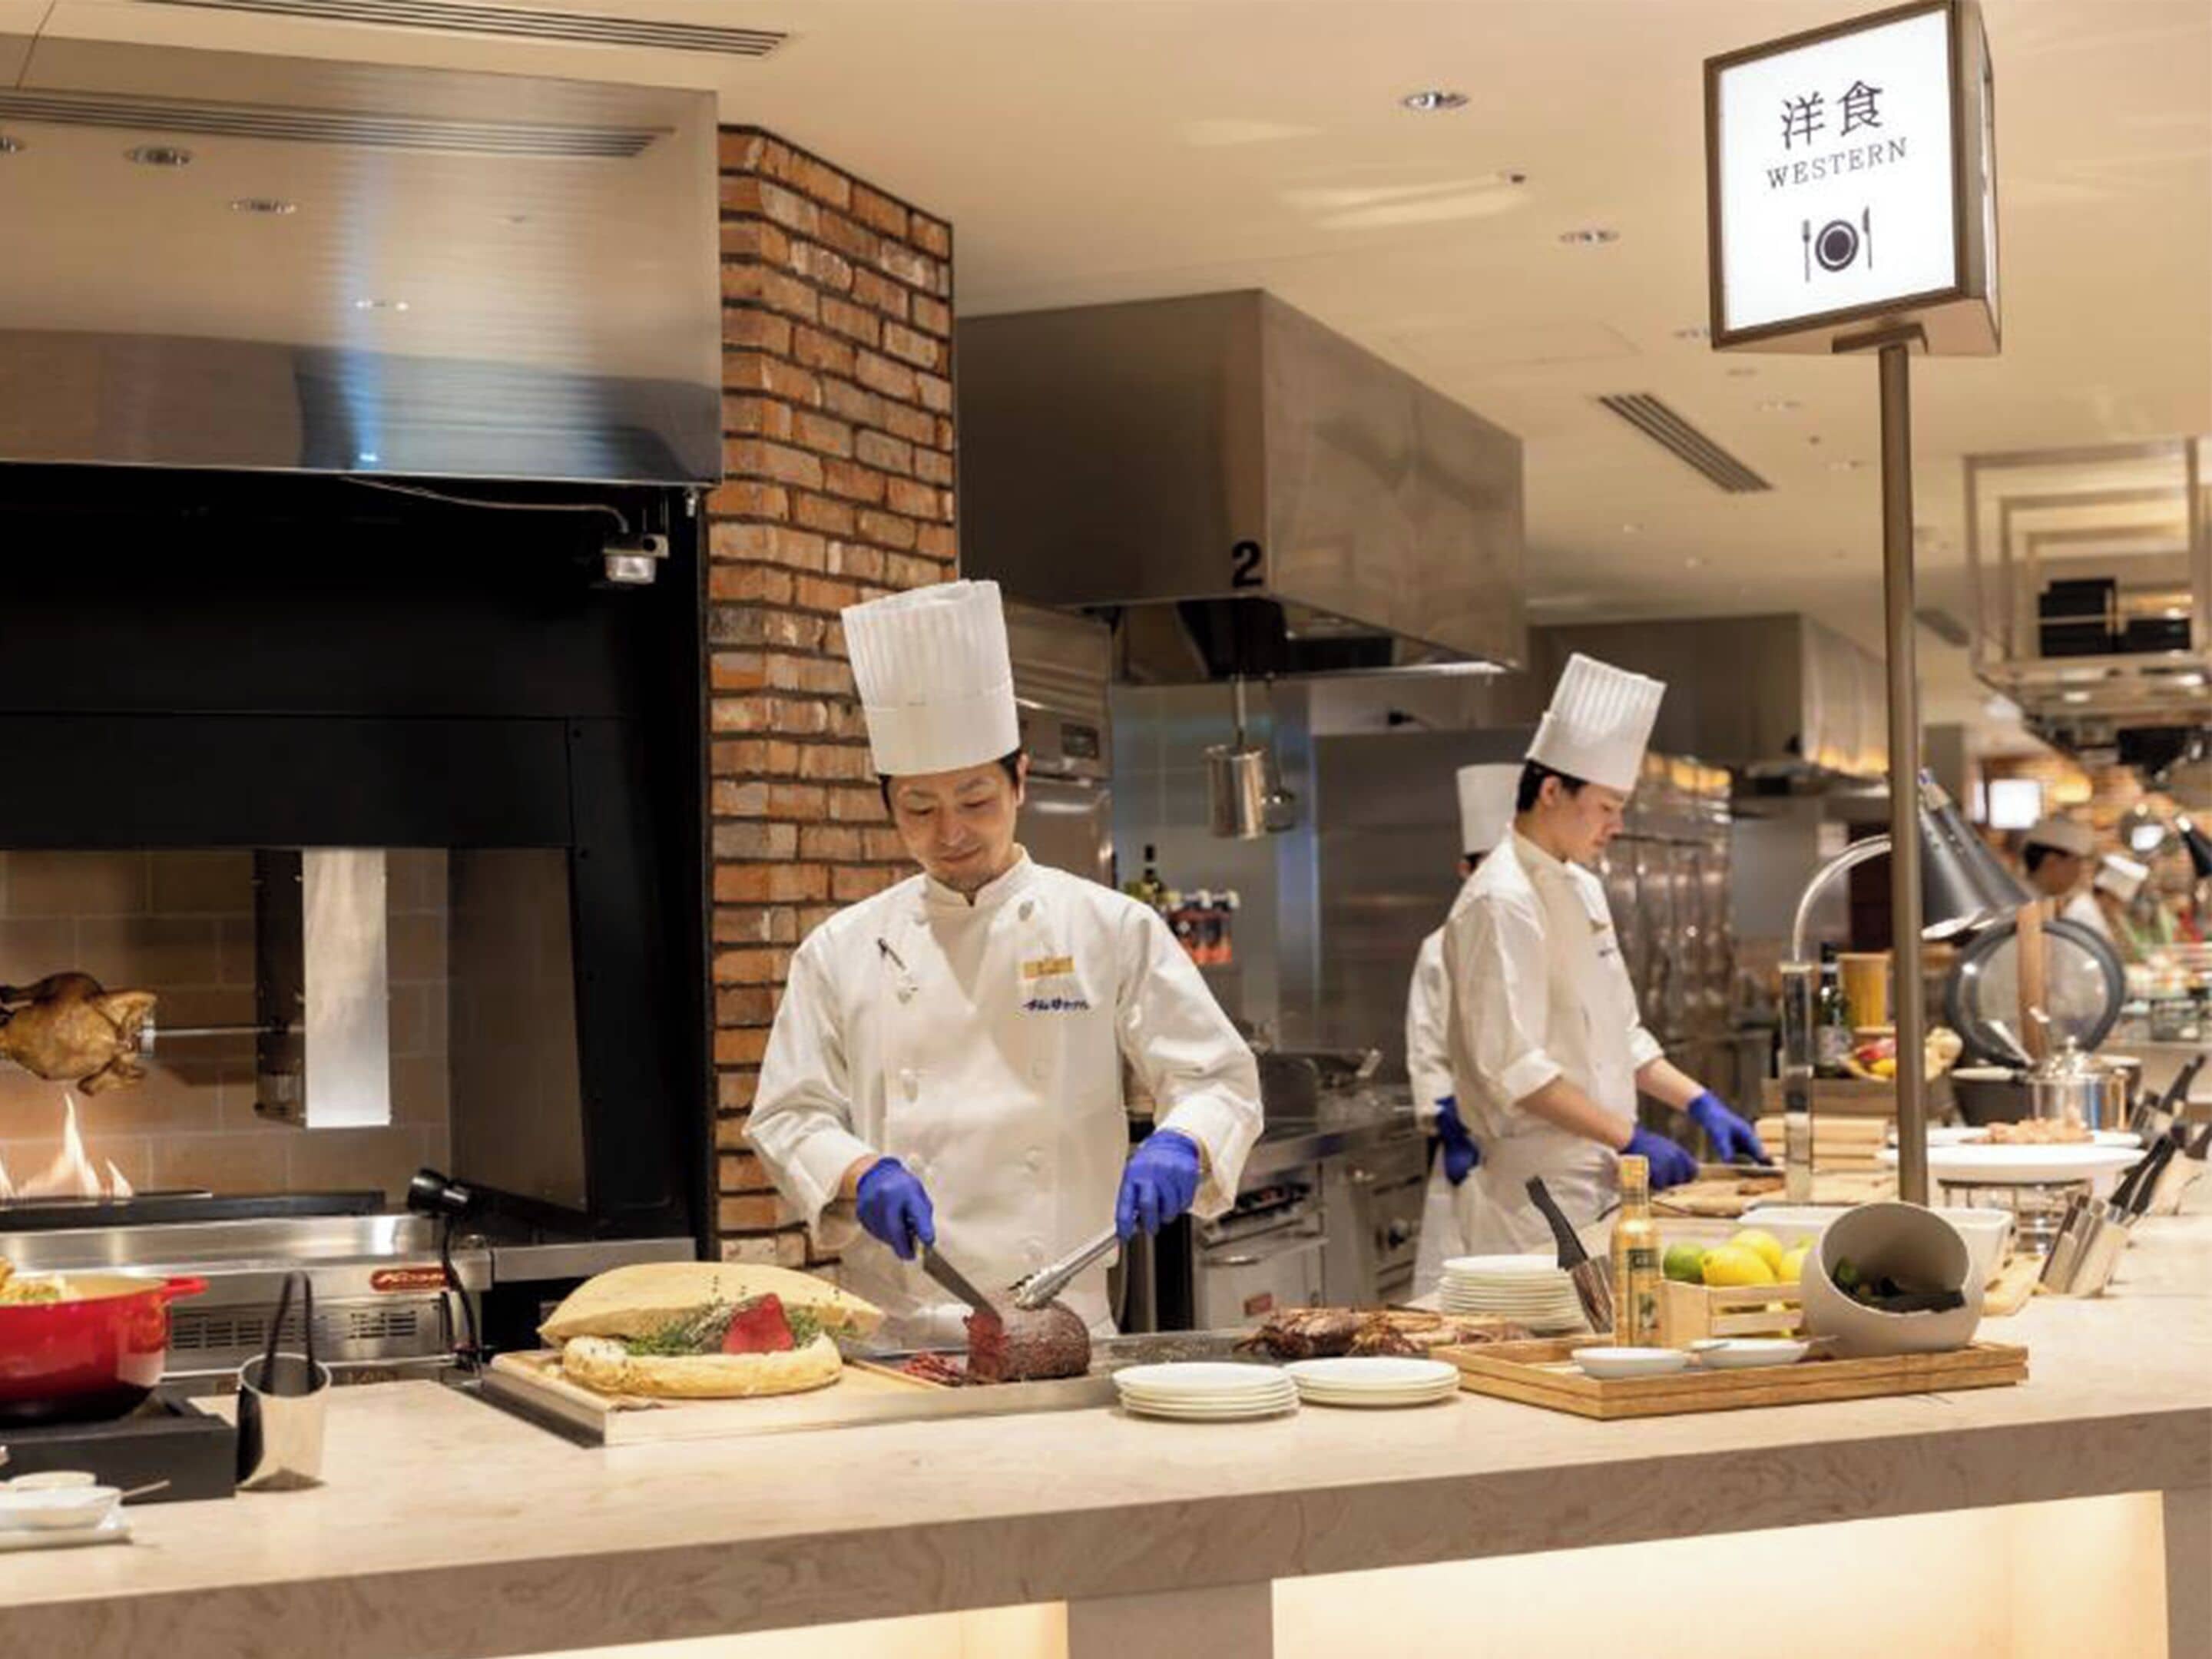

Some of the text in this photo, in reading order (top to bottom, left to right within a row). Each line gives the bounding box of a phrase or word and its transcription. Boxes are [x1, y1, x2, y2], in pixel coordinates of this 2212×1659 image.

[1780, 81, 1883, 150] 洋食
[1767, 137, 1908, 190] WESTERN
[1232, 540, 1263, 588] 2
